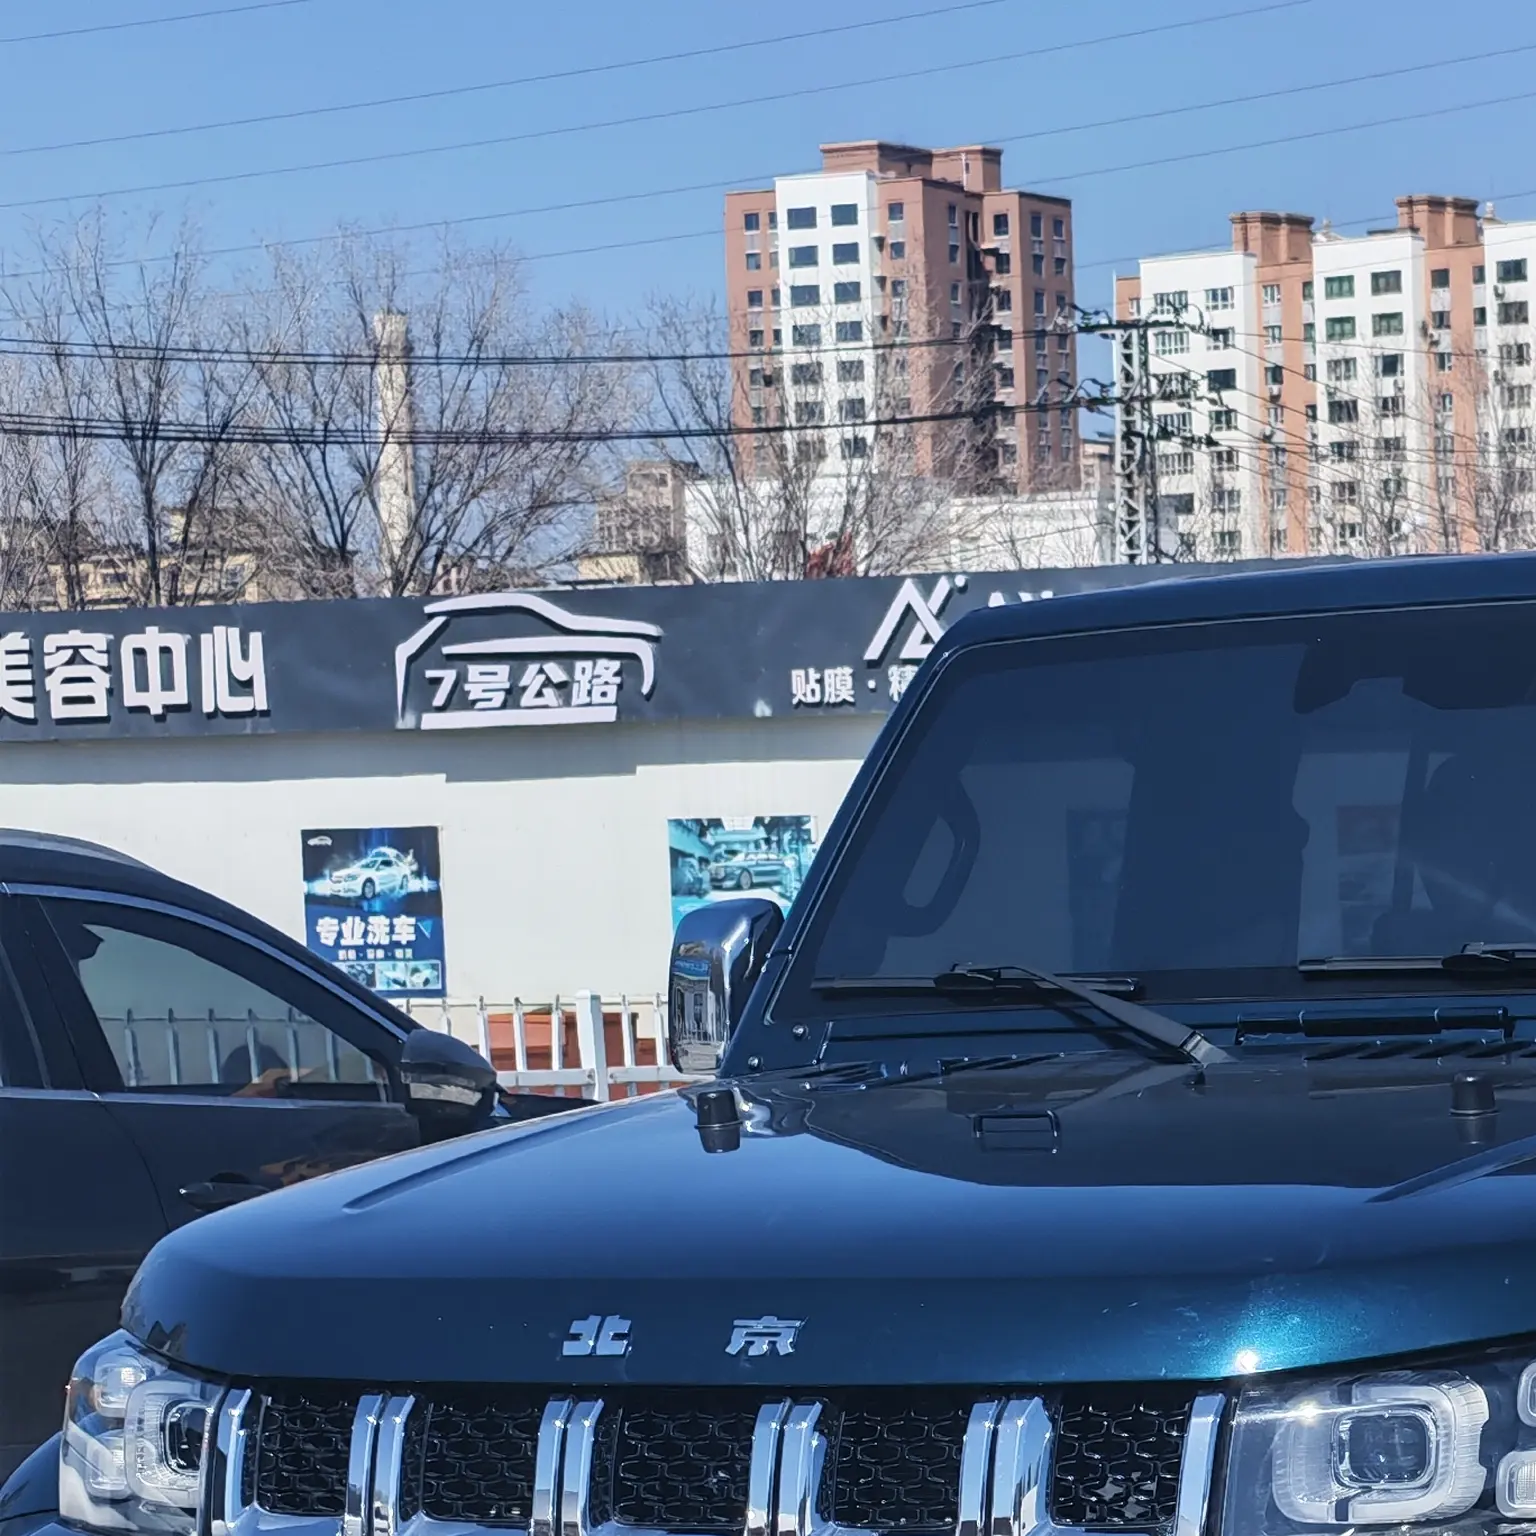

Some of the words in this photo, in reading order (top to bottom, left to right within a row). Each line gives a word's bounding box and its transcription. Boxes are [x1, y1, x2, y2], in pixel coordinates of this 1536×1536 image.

[424, 659, 622, 710] 7号公路
[315, 914, 416, 947] 专业洗车
[562, 1314, 802, 1356] 北京
